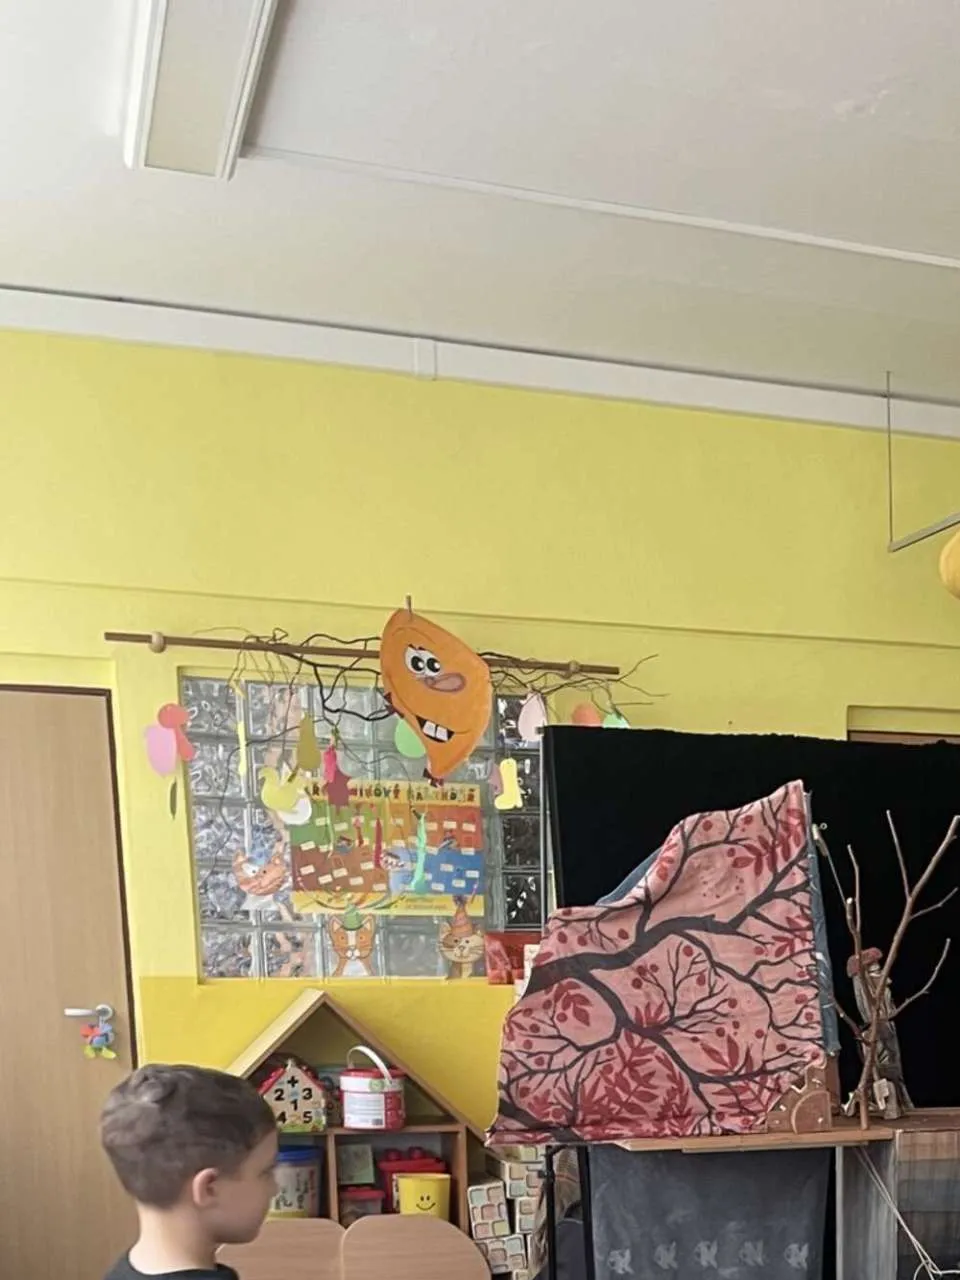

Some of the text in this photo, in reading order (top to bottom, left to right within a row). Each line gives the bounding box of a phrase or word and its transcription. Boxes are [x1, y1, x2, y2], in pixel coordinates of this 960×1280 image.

[274, 1087, 313, 1101] 2 3
[290, 1099, 298, 1111] 1
[276, 1111, 313, 1124] 4 5
